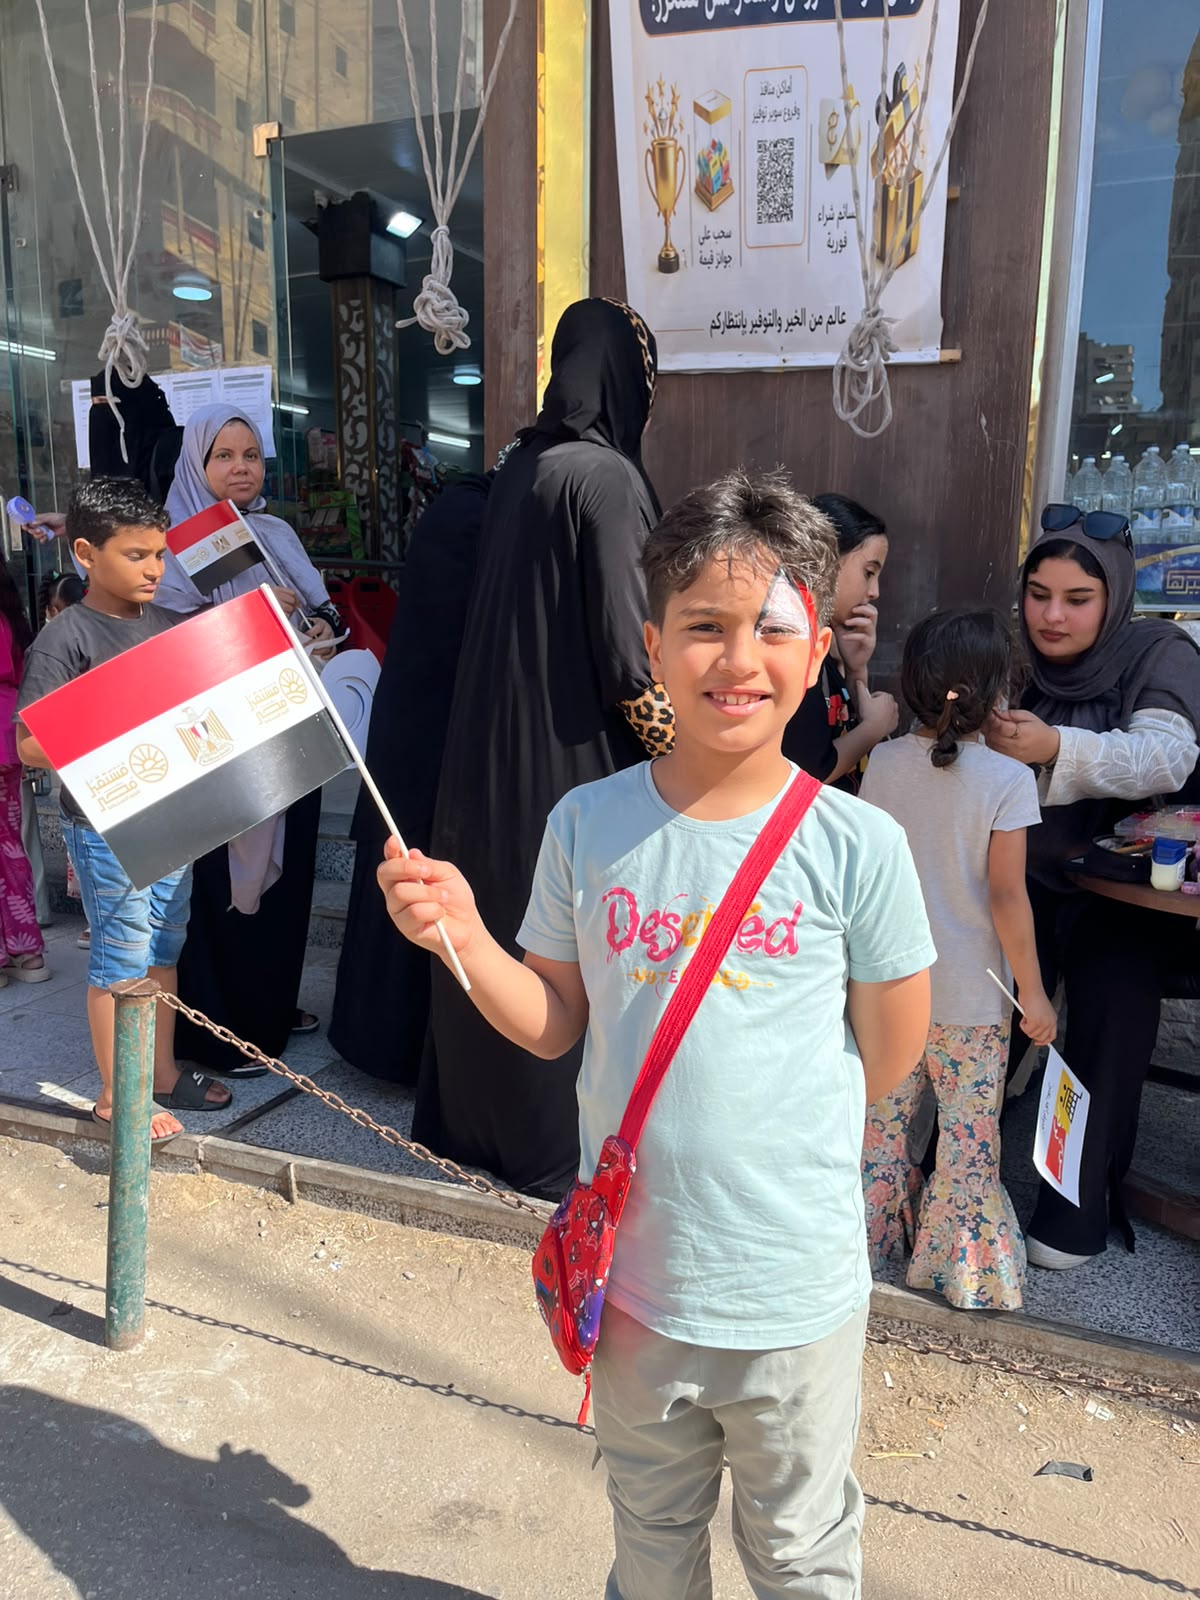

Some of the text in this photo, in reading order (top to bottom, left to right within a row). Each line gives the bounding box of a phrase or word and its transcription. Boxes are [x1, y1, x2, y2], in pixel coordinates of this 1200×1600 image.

[760, 74, 793, 99] أماكن منافذ
[751, 102, 801, 123] وفروع سوبر توفير
[818, 203, 857, 229] سائم شراء
[698, 224, 732, 246] سحب على
[827, 231, 847, 254] فورية
[699, 249, 714, 270] قيمة
[715, 249, 733, 269] جوائز
[749, 308, 783, 335] والتوفير
[784, 307, 807, 333] الخير
[809, 313, 824, 333] من
[825, 305, 847, 334] عالم
